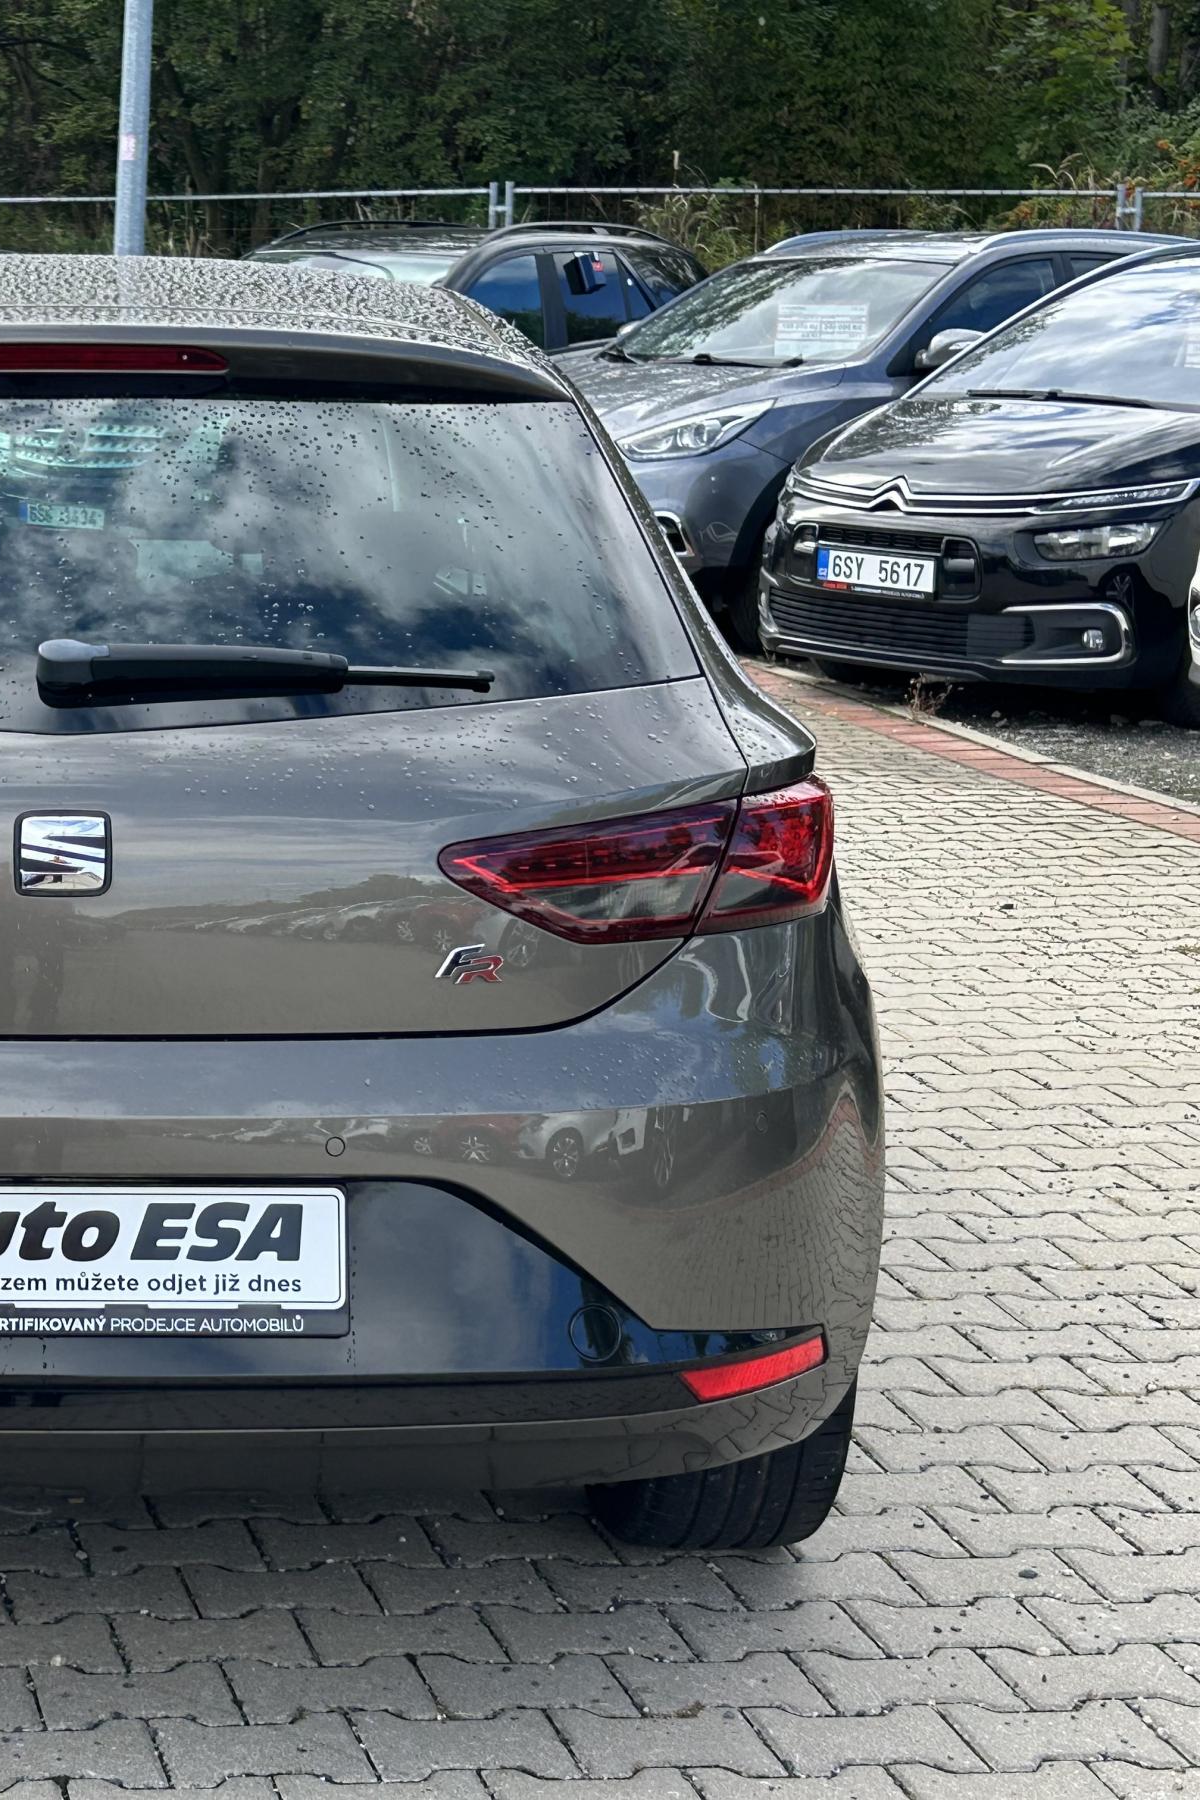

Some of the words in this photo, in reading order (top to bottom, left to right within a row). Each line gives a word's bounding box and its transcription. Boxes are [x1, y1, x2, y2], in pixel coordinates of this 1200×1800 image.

[832, 555, 865, 581] 6SY
[878, 560, 925, 587] 5617
[434, 943, 504, 985] FR
[129, 1201, 304, 1262] ESA
[55, 1271, 140, 1292] můžete
[147, 1273, 208, 1295] odjet
[213, 1273, 241, 1296] již
[247, 1274, 302, 1292] dnes
[110, 1317, 196, 1332] PRODEJCE
[199, 1314, 304, 1332] AUTOMOBILŮ
